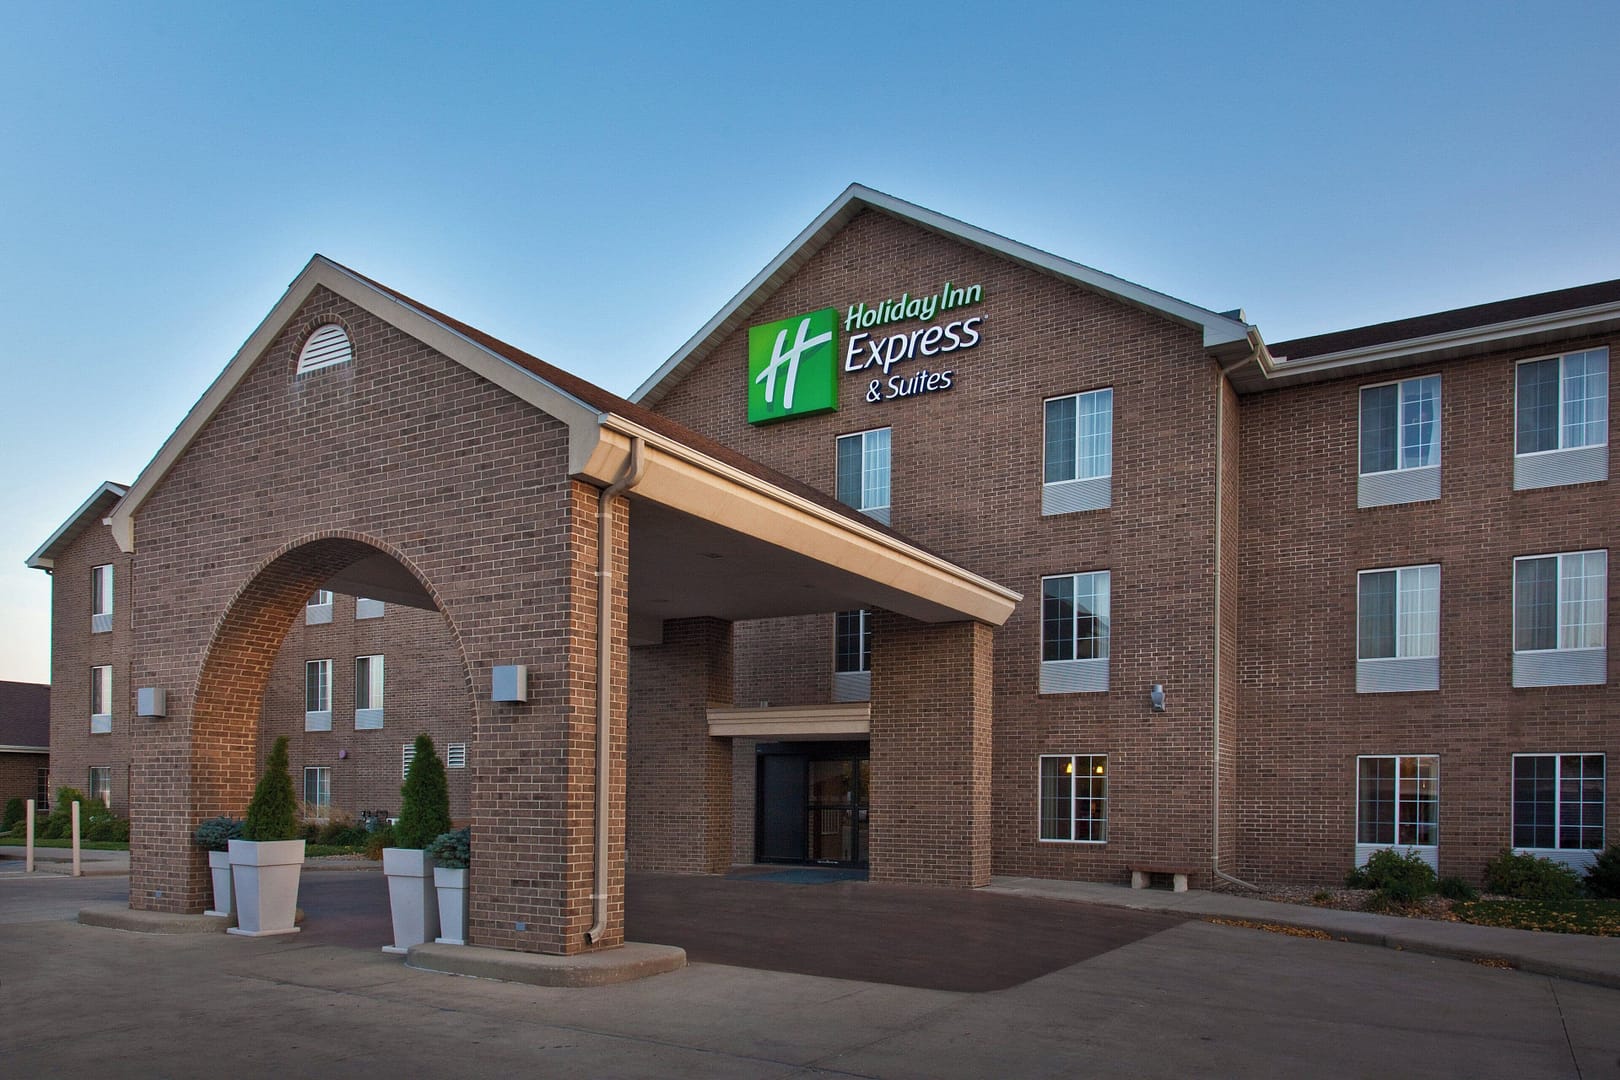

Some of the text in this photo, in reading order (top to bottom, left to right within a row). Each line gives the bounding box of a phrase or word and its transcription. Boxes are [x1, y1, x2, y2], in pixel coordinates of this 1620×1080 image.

[844, 281, 982, 331] Holiday Inn
[845, 316, 981, 374] Express
[866, 370, 952, 402] & Suites
